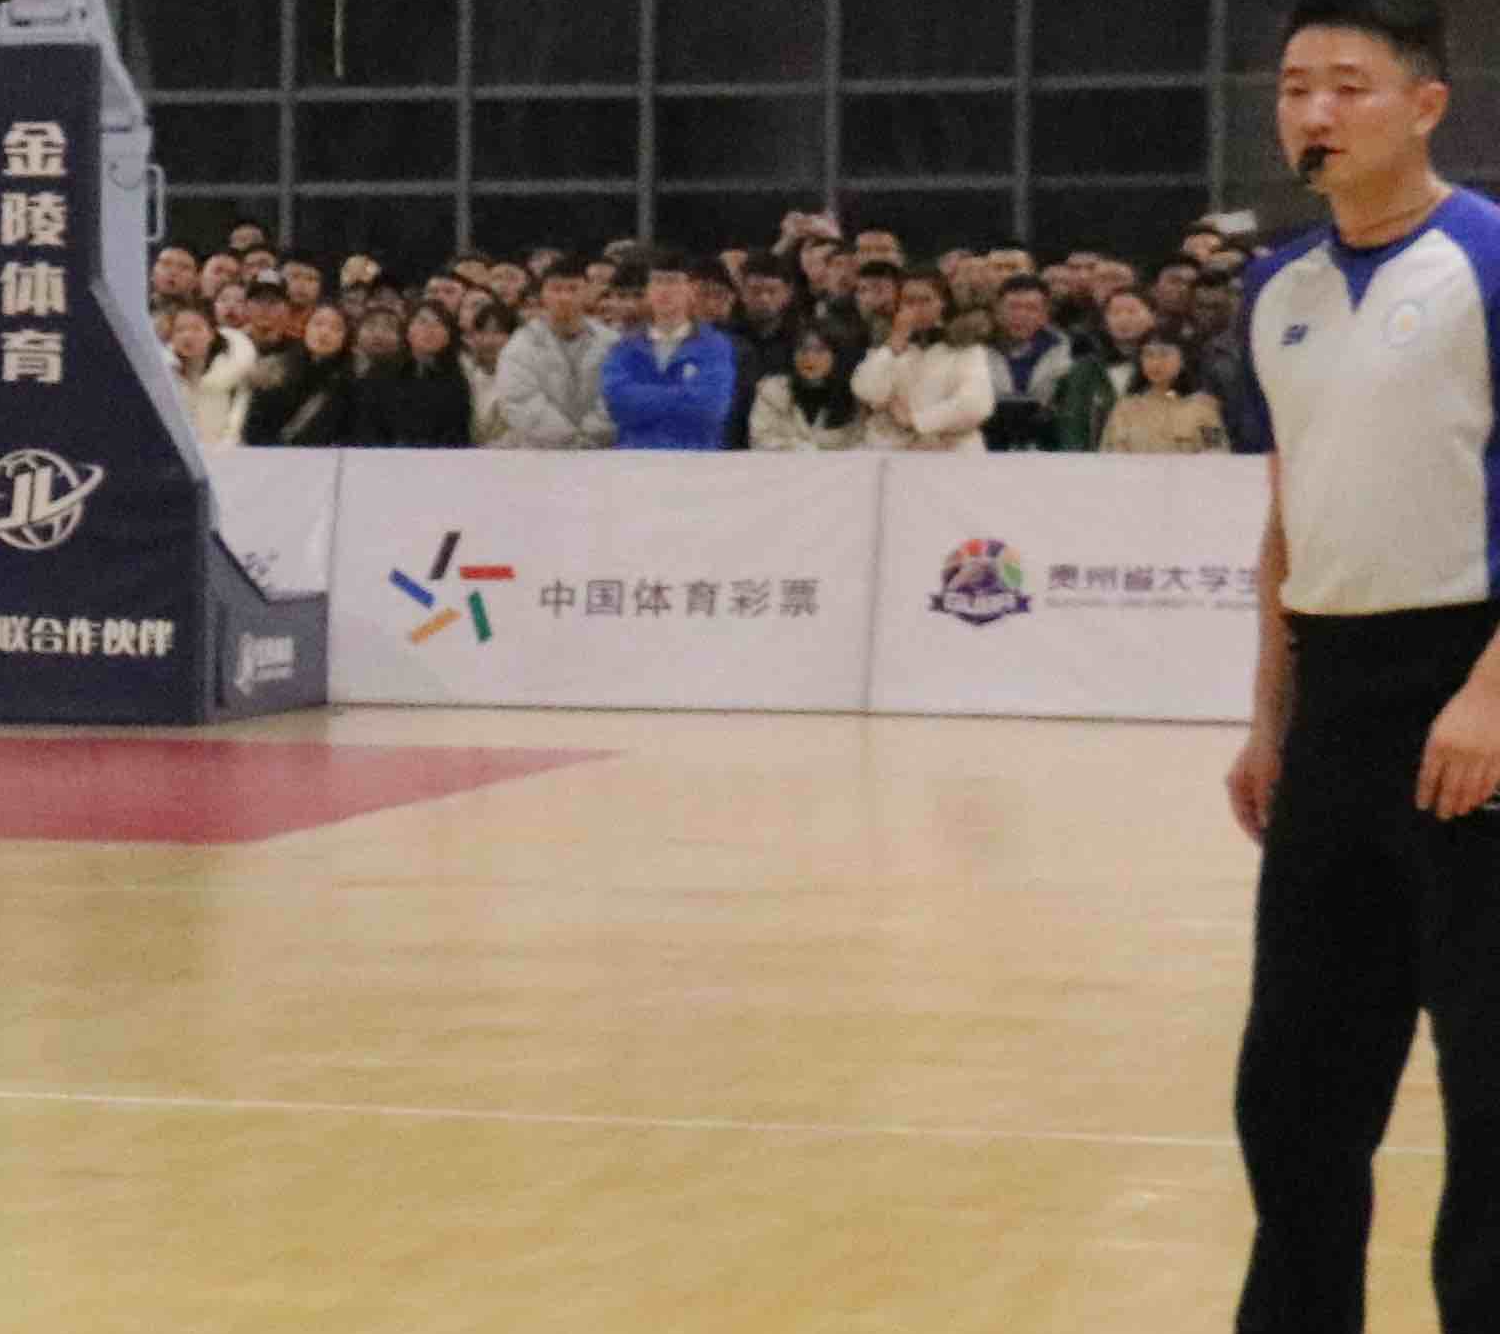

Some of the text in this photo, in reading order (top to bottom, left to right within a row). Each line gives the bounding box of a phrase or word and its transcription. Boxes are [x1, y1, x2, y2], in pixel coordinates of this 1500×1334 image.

[0, 120, 67, 385] 金陵体育
[539, 578, 821, 619] 中国体育彩票
